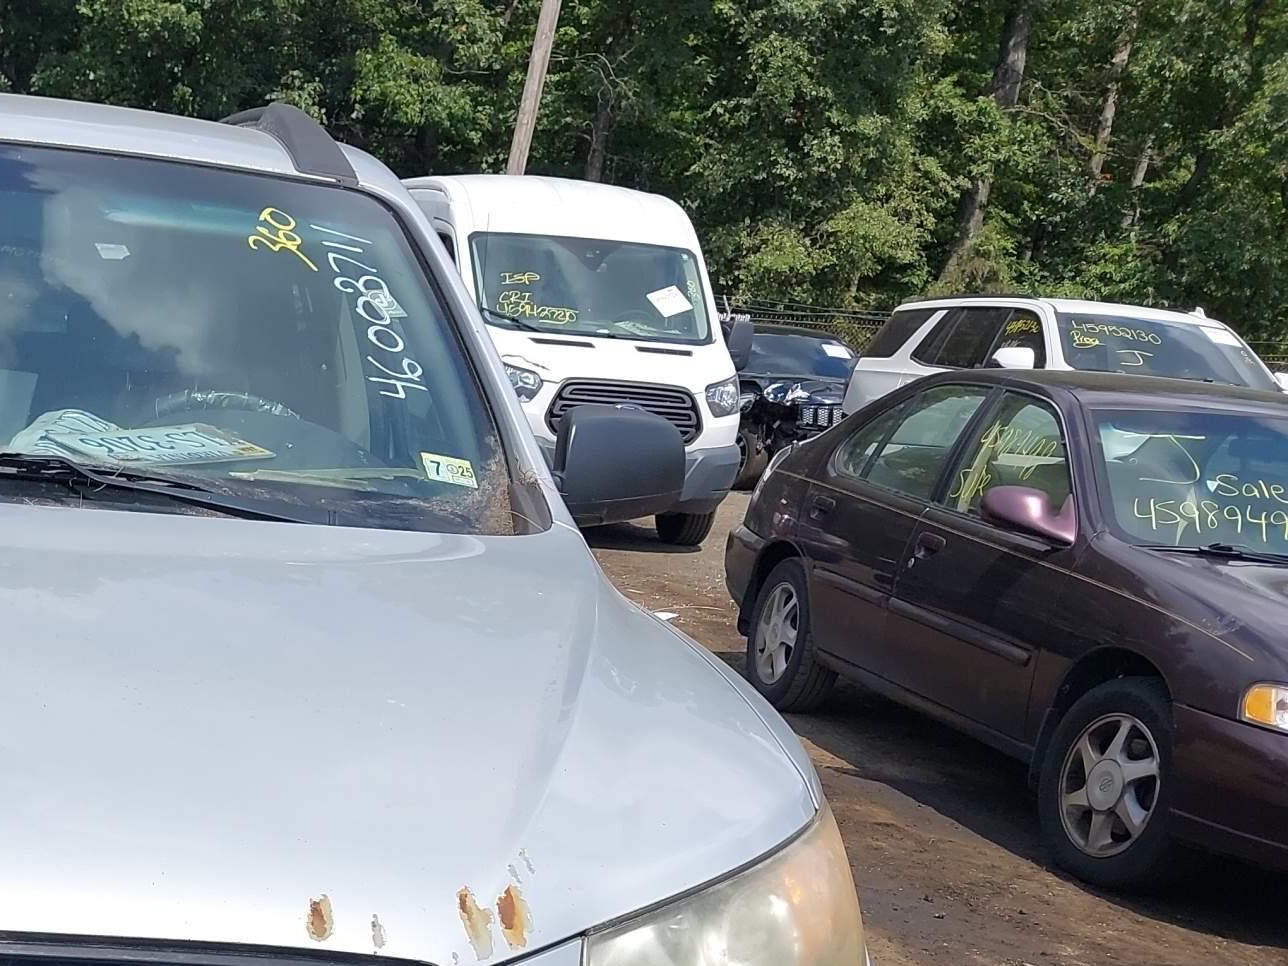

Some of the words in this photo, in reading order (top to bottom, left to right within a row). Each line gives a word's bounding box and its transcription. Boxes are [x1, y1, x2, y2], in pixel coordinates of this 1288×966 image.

[248, 206, 319, 272] 360
[310, 223, 429, 400] 46003711
[430, 460, 441, 476] 7
[458, 465, 473, 478] 25
[1215, 473, 1288, 504] Sale
